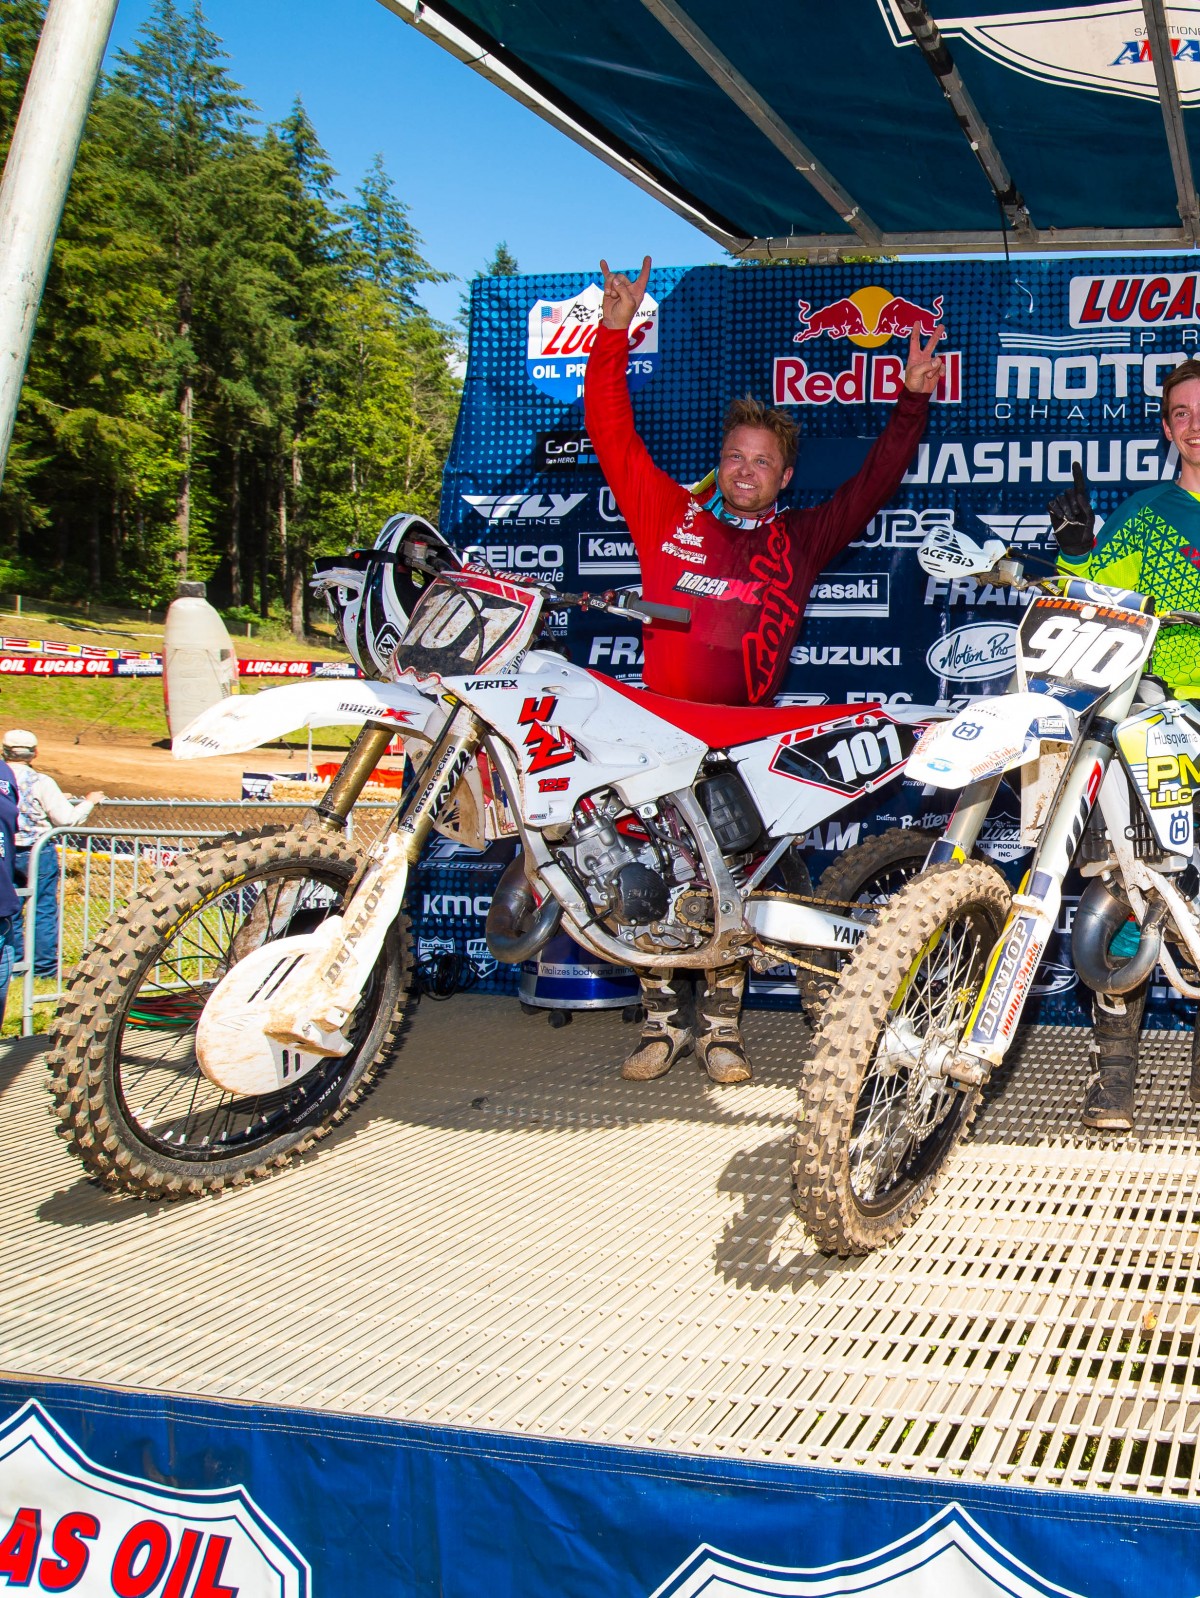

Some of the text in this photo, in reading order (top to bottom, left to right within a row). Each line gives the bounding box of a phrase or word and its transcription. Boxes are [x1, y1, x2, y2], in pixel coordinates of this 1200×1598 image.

[541, 321, 654, 356] LUCS
[532, 364, 561, 380] OIL
[773, 350, 963, 405] Red Bll
[488, 518, 561, 526] RACING
[920, 546, 976, 568] ACERBIS
[676, 571, 729, 596] RACER
[401, 588, 524, 662] 101
[788, 645, 901, 666] SUZUKI
[939, 634, 989, 670] Motion
[1021, 615, 1146, 689] 910
[33, 660, 85, 673] LUCAS
[86, 660, 111, 673] OIL
[246, 662, 288, 674] LUCAS
[288, 663, 309, 674] OIL
[464, 679, 519, 691] VERTEX
[1153, 732, 1199, 748] Husqvarna
[827, 724, 904, 783] 101
[537, 777, 571, 793] 125
[1149, 788, 1194, 810] LLC
[982, 828, 1021, 841] LUCA
[420, 861, 503, 870] PROGRIP
[321, 875, 388, 985] DUNLOP
[422, 917, 481, 925] WHEEL
[540, 965, 570, 975] Vitalizes
[572, 965, 594, 977] body
[597, 965, 613, 975] and
[978, 918, 1030, 1040] DUNLOP
[111, 1518, 240, 1598] OIL
